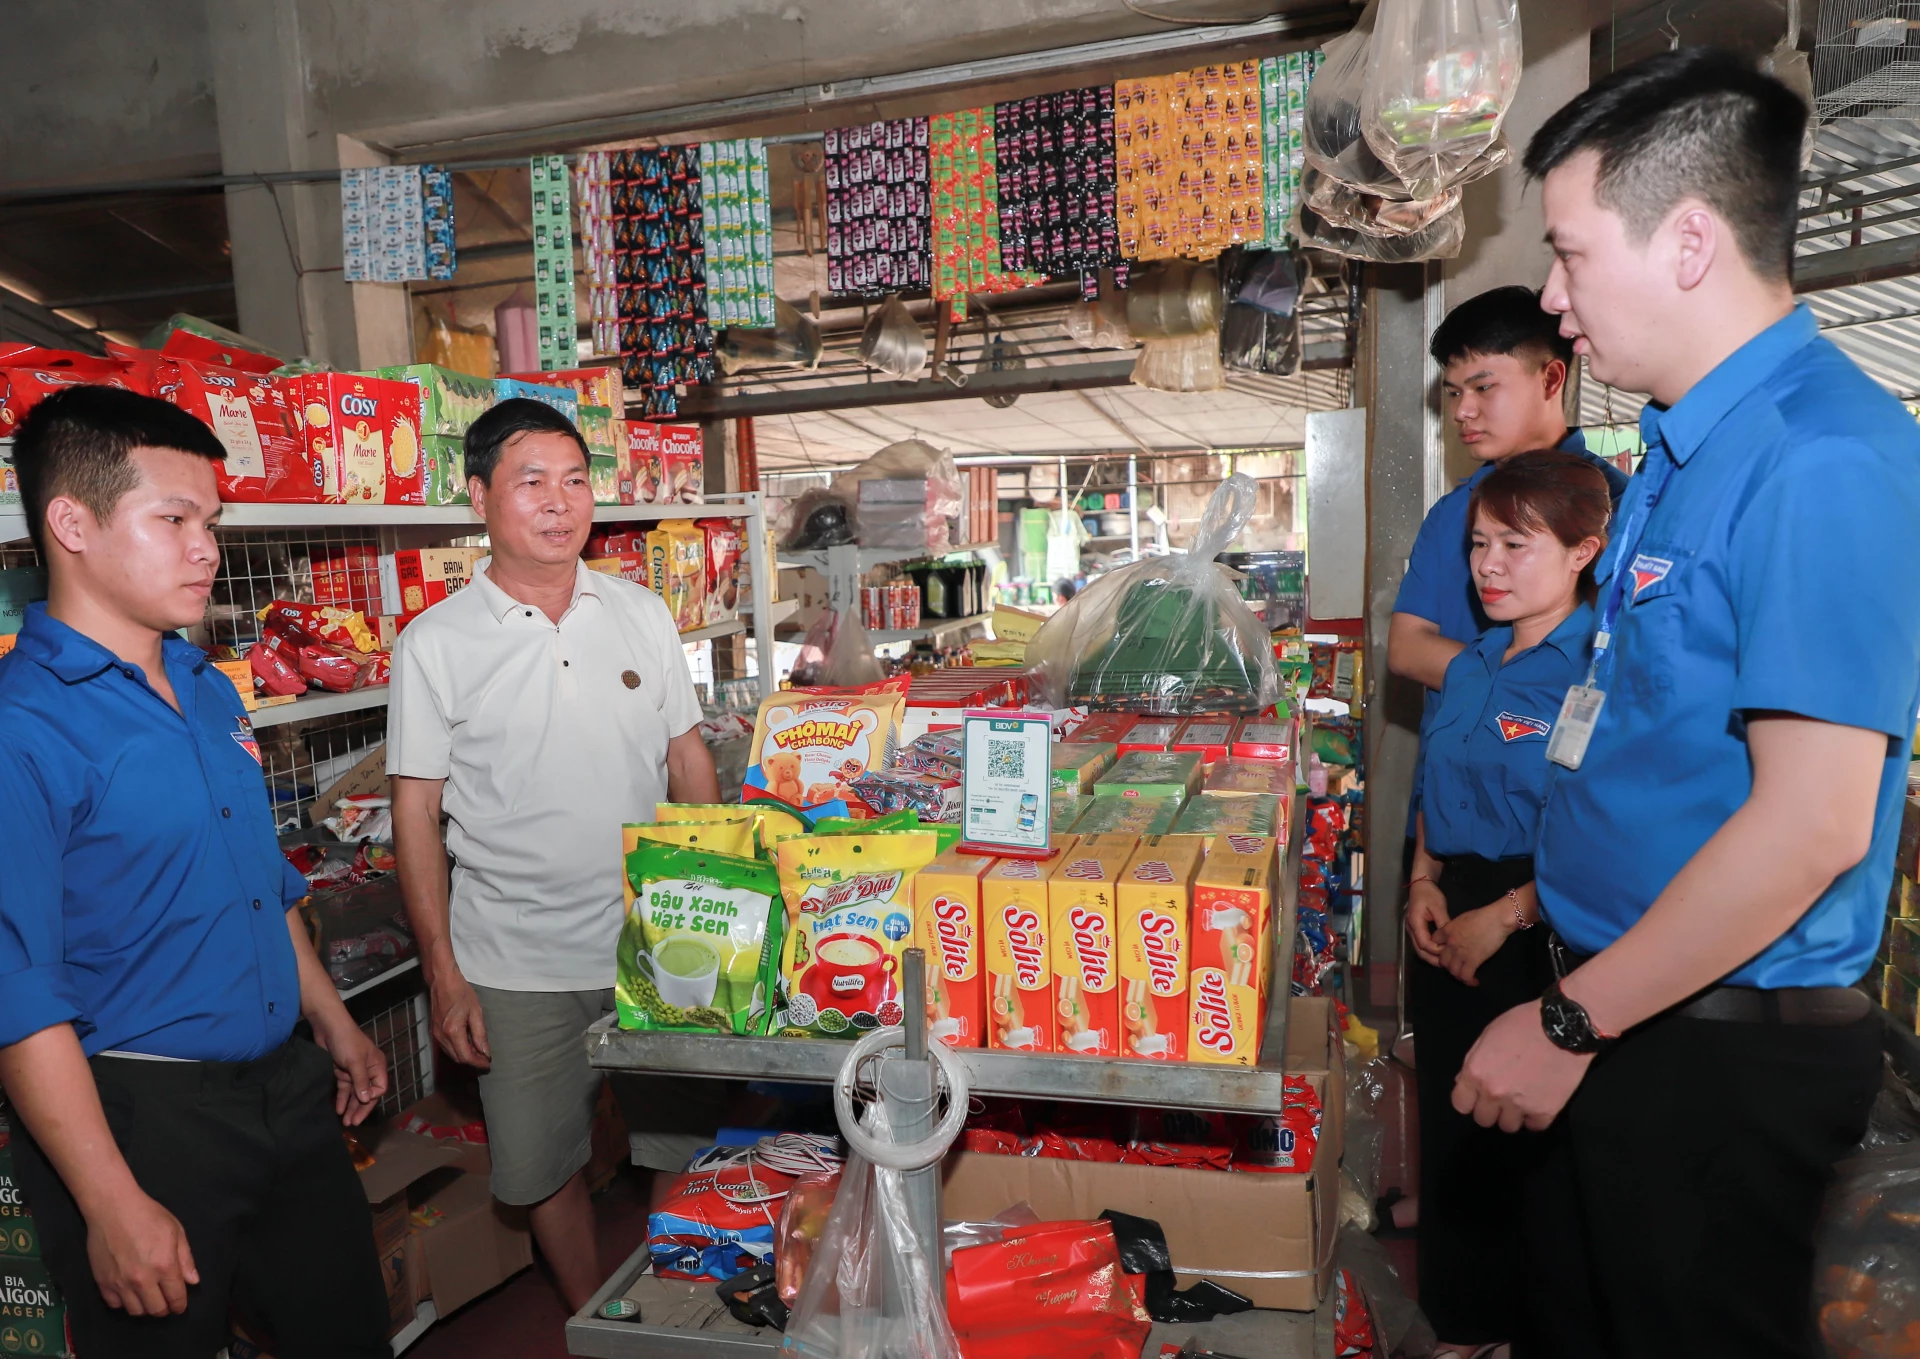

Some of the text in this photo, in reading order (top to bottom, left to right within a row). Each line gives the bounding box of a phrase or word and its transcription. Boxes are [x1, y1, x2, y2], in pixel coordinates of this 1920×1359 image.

[201, 376, 237, 388] COSY
[219, 404, 248, 419] Marie
[340, 394, 378, 418] COSY
[353, 443, 377, 458] Marie
[662, 438, 701, 455] ChocoPie
[313, 458, 324, 487] COSY
[443, 558, 464, 574] BÁNH
[995, 722, 1012, 730] BIDV
[688, 895, 738, 918] Xanh
[651, 909, 729, 937] Hạt Sen
[813, 912, 879, 932] Hạt Sen
[933, 897, 971, 978] Solite
[1003, 905, 1045, 988] Solite
[1069, 907, 1110, 989] Solite
[1138, 909, 1181, 996] Solite
[1197, 971, 1235, 1055] Solite
[0, 1176, 13, 1187] IA
[1007, 1252, 1058, 1270] Khang
[5, 1276, 25, 1288] BIA
[0, 1287, 50, 1307] AIGON
[2, 1305, 45, 1319] AGER
